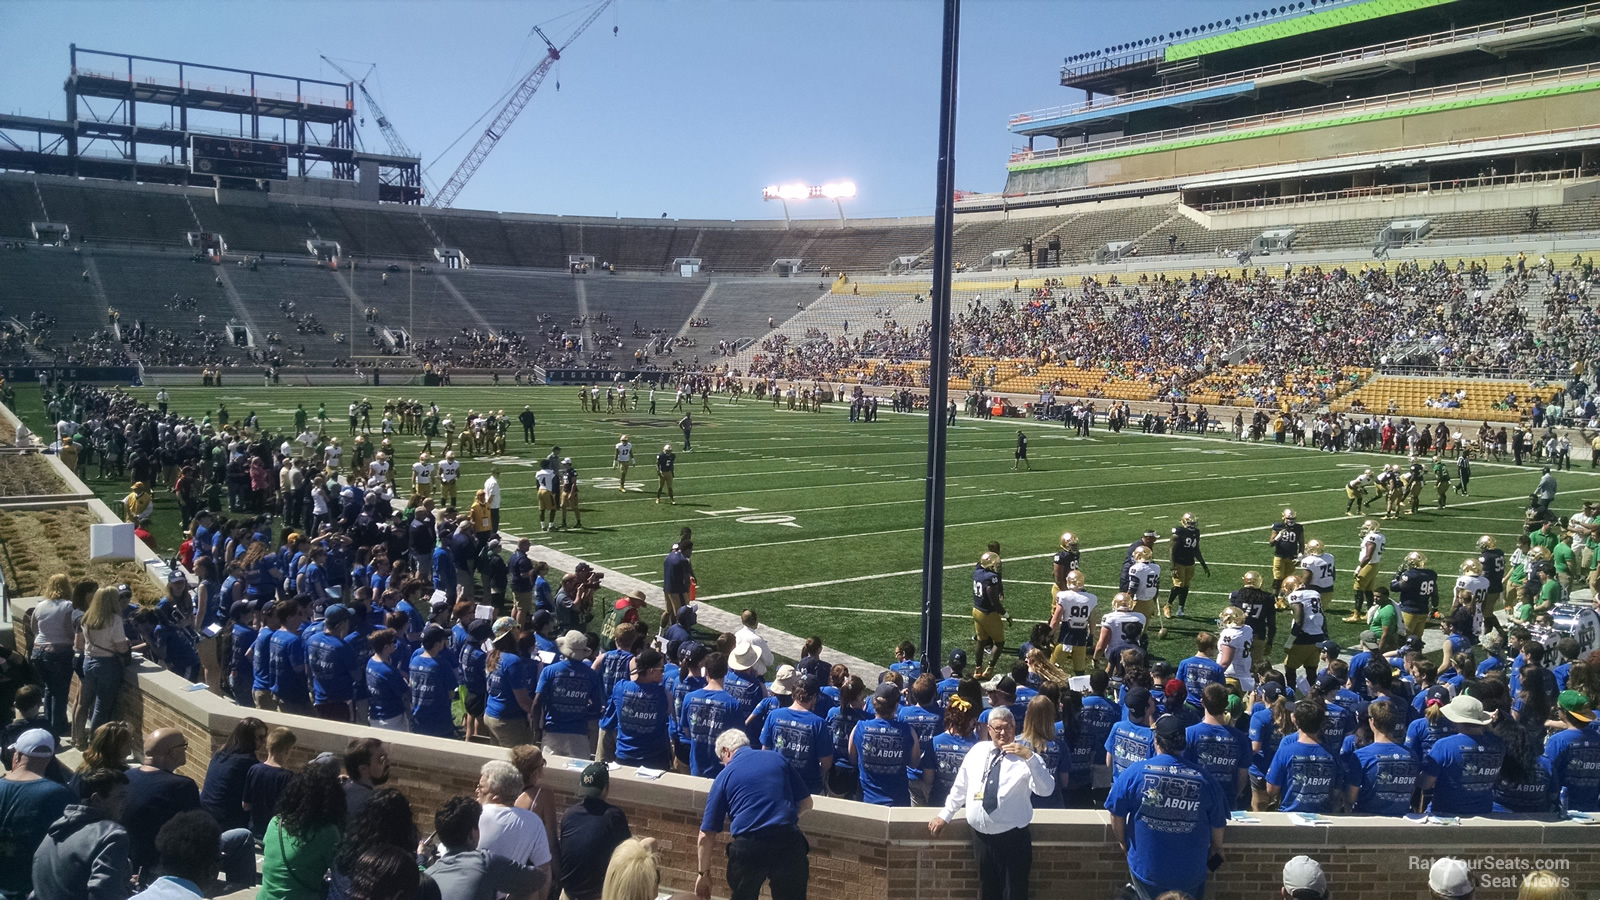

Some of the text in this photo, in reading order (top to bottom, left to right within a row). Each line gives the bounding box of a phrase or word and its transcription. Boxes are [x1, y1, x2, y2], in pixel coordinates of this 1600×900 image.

[1184, 537, 1197, 548] 94
[1320, 565, 1333, 579] 75
[1420, 580, 1434, 596] 96
[565, 690, 588, 699] ABOVE
[634, 711, 658, 720] ABOVE
[701, 720, 724, 730] ABOVE
[786, 743, 810, 753] ABOVE
[877, 750, 904, 758] ABOVE
[1212, 757, 1238, 766] ABOVE
[1307, 777, 1332, 786] ABOVE
[1392, 776, 1416, 785] ABOVE
[1141, 773, 1201, 800] RISE
[1516, 784, 1546, 792] ABOVE
[1163, 797, 1200, 812] ABOVE
